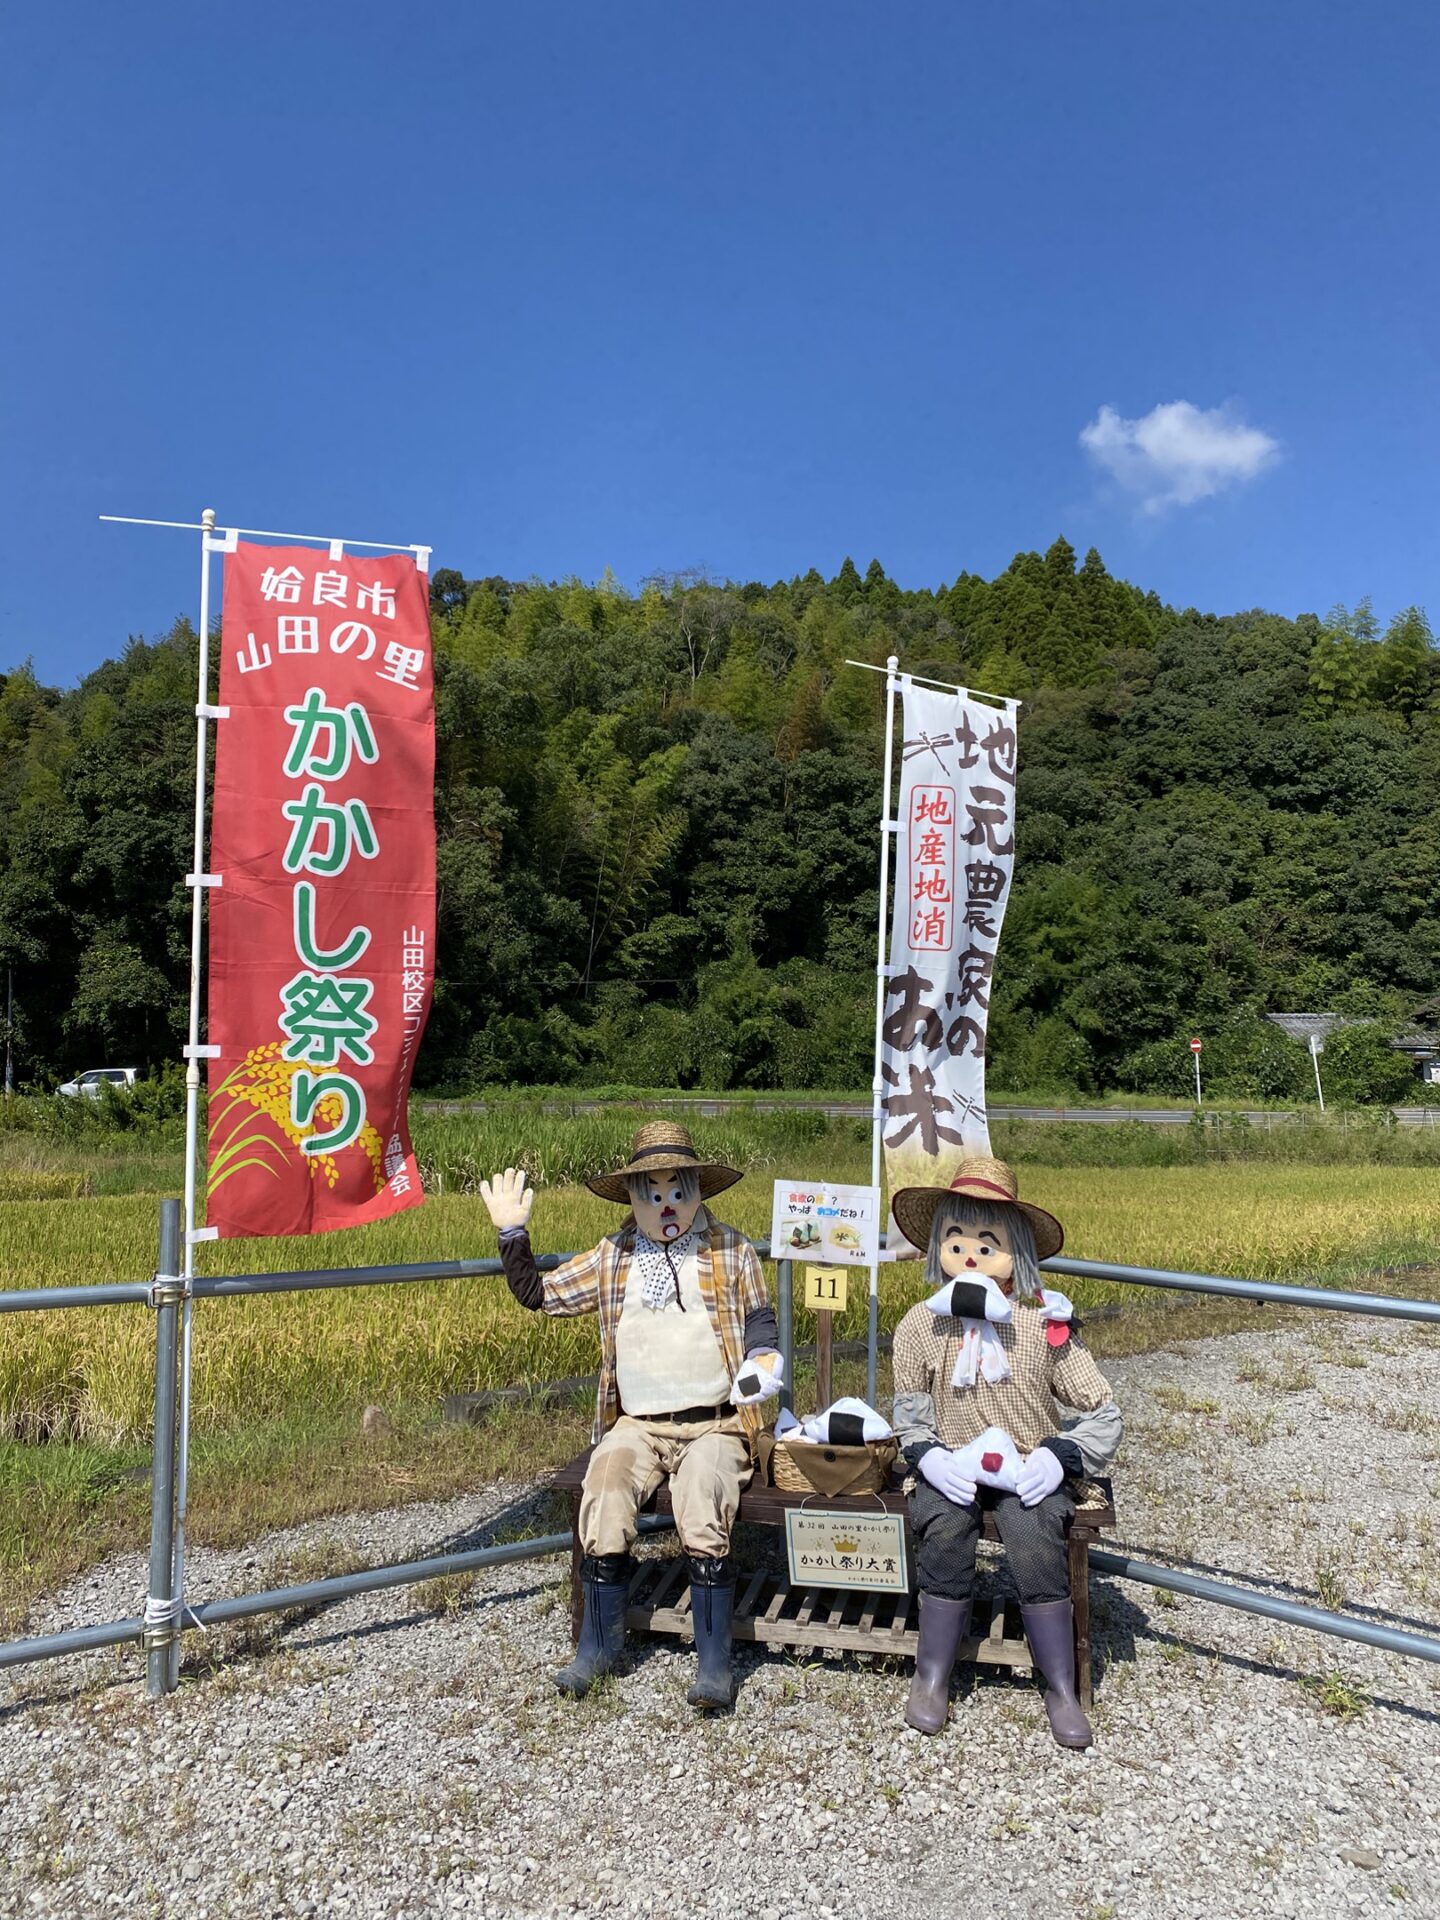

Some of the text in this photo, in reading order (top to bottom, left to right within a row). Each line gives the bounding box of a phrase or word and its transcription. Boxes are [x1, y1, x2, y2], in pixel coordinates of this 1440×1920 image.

[261, 566, 396, 619] 姶良市
[236, 615, 424, 691] 山田の里
[277, 686, 380, 1157] かかし祭り
[913, 791, 953, 946] 地産地消
[946, 710, 1016, 1058] 地元農家の
[881, 964, 964, 1156] お米
[814, 1277, 839, 1299] 11
[800, 1555, 897, 1573] かかし祭り大賞
